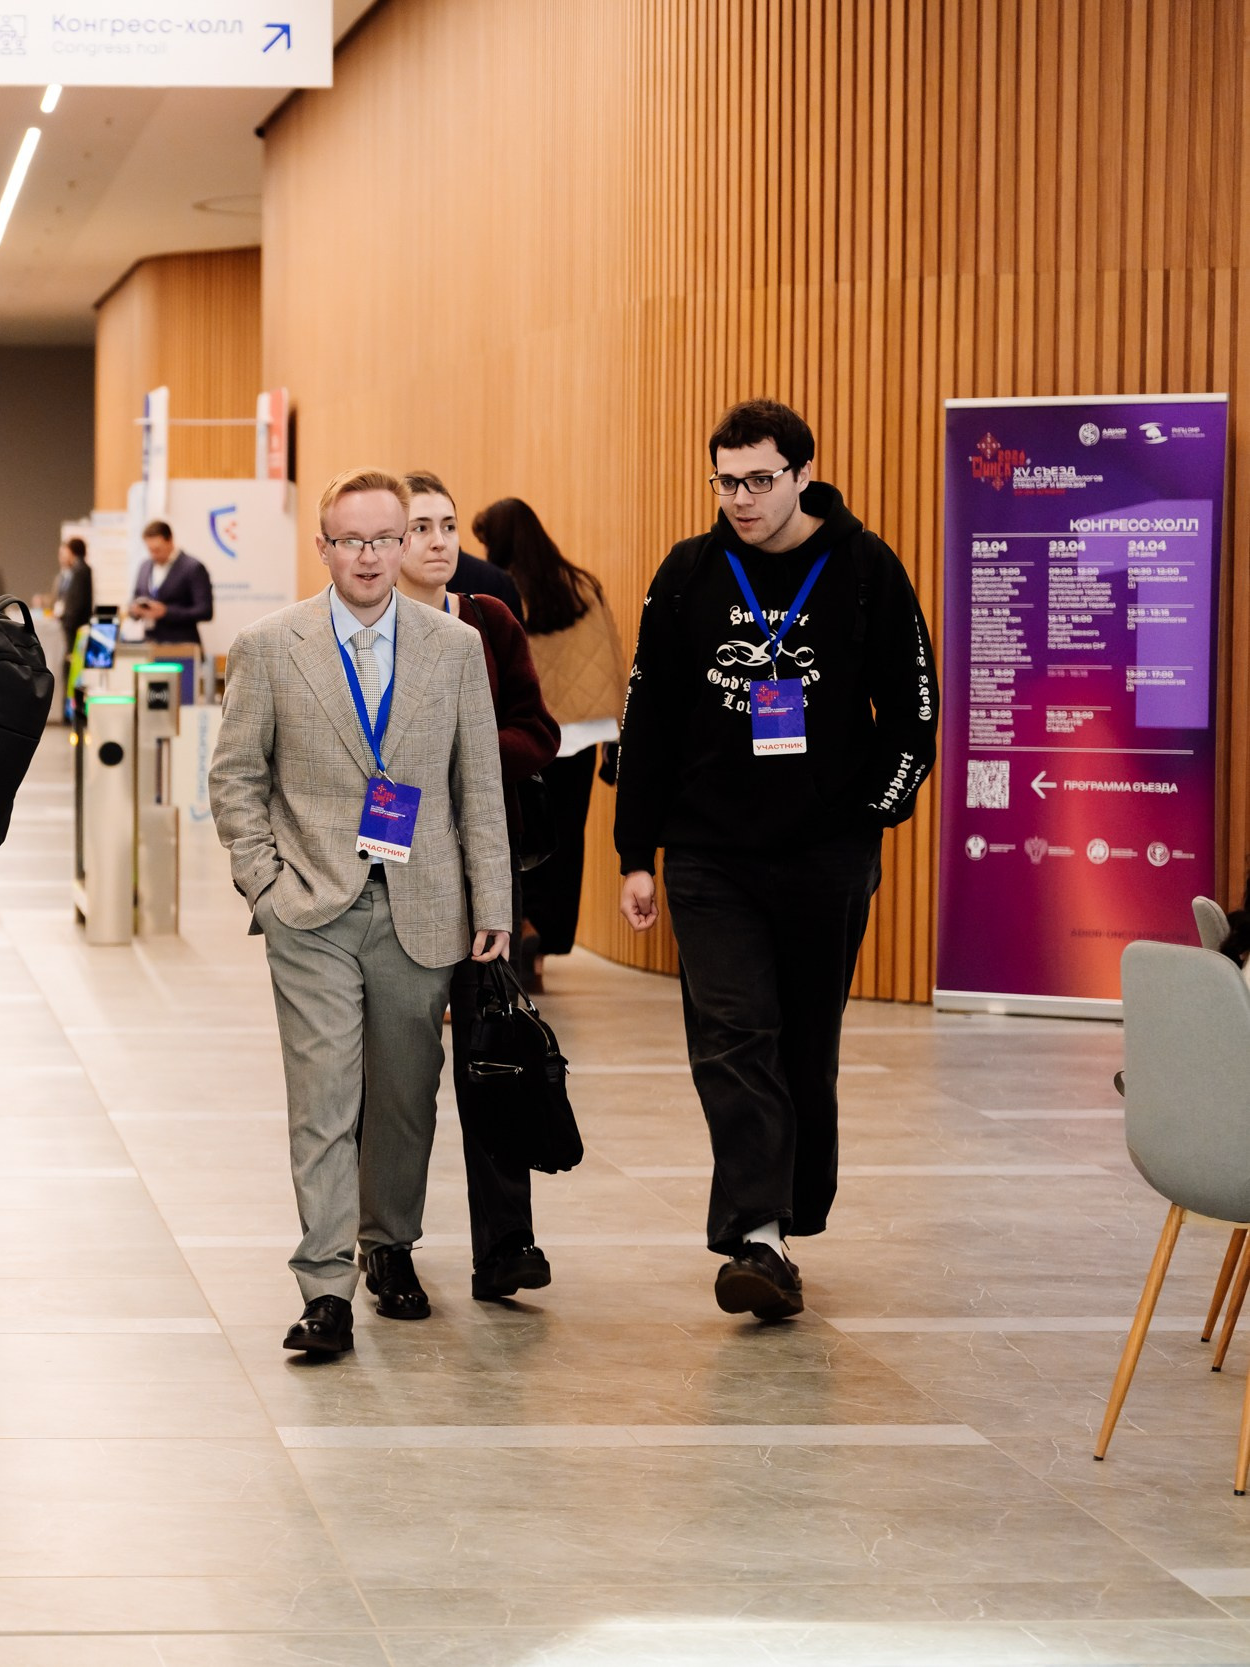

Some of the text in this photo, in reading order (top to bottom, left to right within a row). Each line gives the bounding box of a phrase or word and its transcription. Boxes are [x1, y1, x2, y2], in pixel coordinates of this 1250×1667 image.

[51, 14, 244, 36] Конгресс-холл
[52, 41, 132, 56] Congress
[1033, 466, 1076, 477] СЪЕЗД
[1069, 518, 1199, 532] КОНГРЕСС-ХОЛЛ
[1128, 540, 1167, 552] 24.04
[756, 742, 803, 751] УЧАСТНИК
[868, 752, 914, 811] upport
[1063, 780, 1179, 794] ПРОГРАММА СЪЕЗДА
[359, 841, 407, 859] УЧАСТНИК
